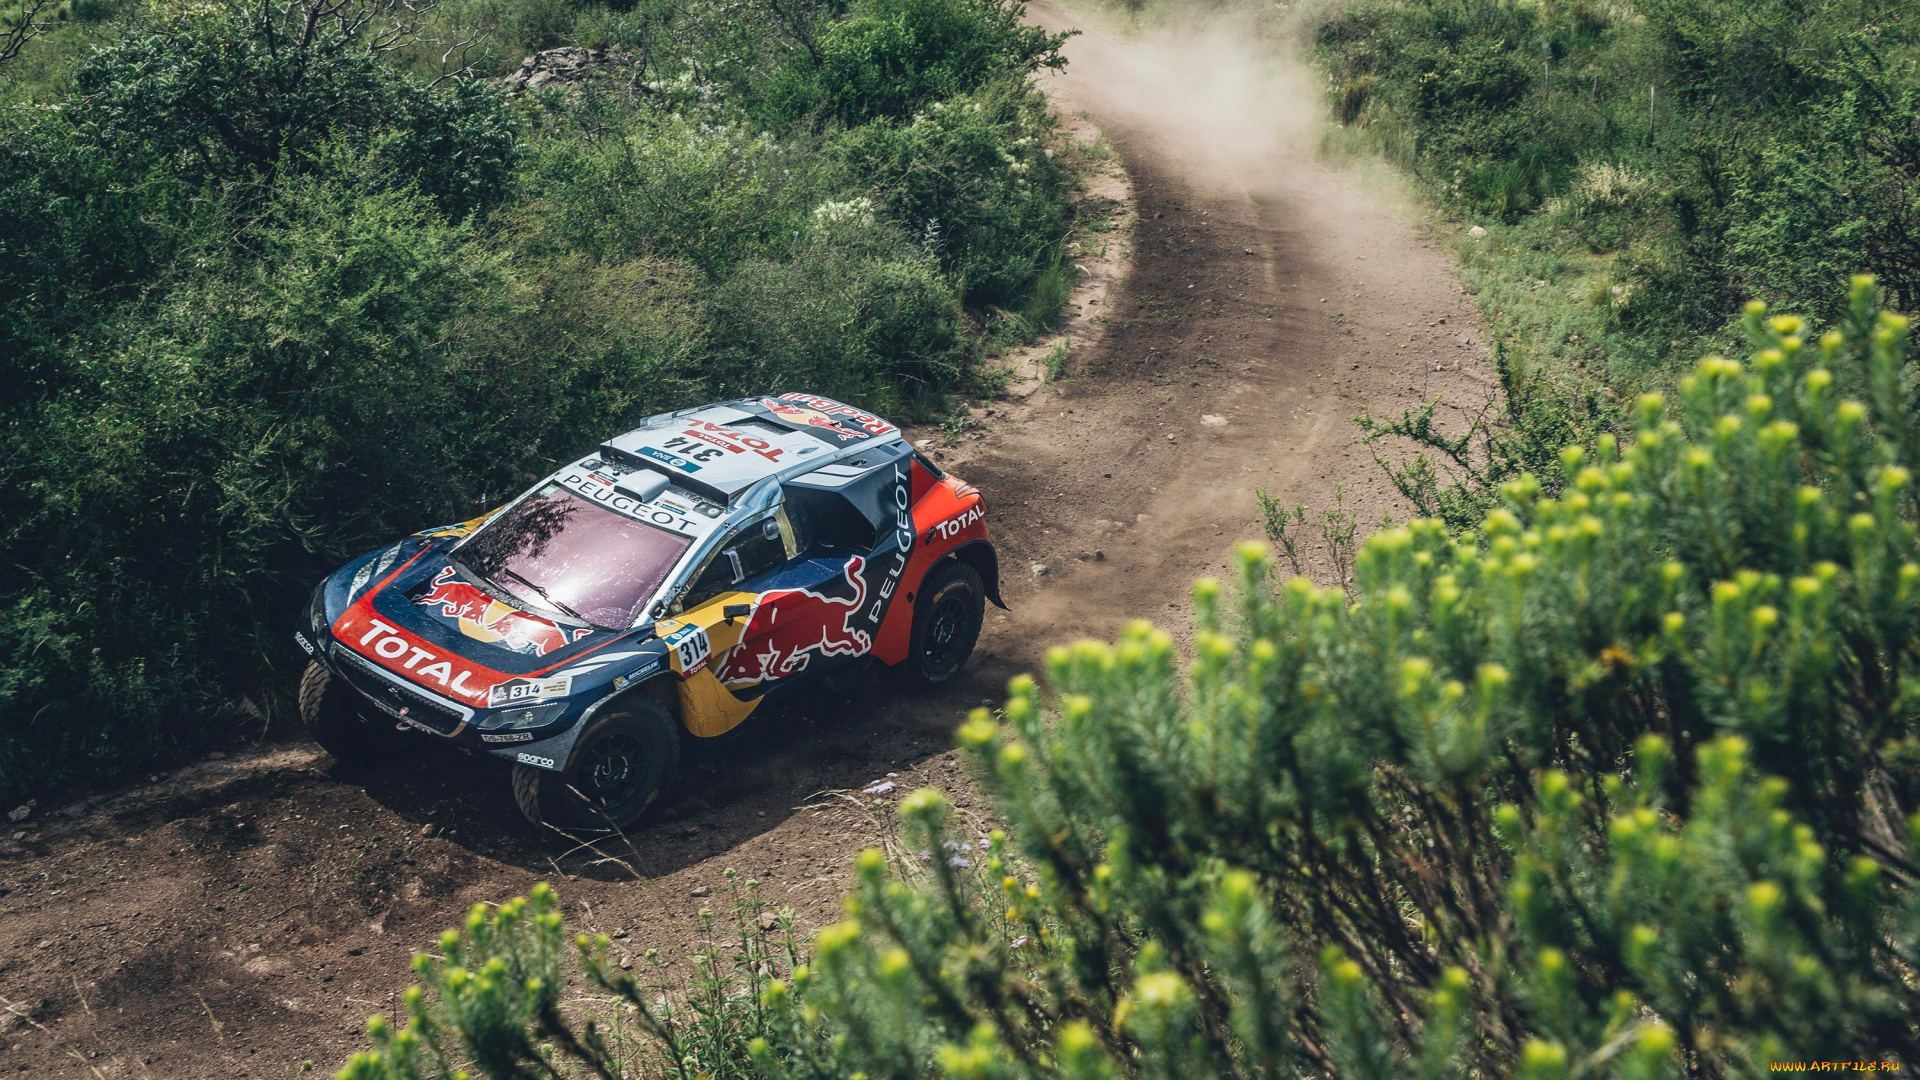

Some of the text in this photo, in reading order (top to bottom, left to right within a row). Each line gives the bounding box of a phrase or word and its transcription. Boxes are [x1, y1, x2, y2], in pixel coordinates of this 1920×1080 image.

[663, 436, 724, 462] 314
[687, 418, 783, 463] TOTAL
[563, 474, 697, 531] PEUGEOT
[935, 504, 985, 540] TOTAL
[868, 463, 912, 624] PEUGEOT
[295, 631, 314, 654] sparco
[680, 632, 708, 667] 314
[360, 618, 474, 698] TOTAL
[628, 661, 658, 680] MICHELIN
[689, 660, 708, 675] TOTAL
[513, 684, 541, 697] 314
[517, 752, 555, 767] sparco
